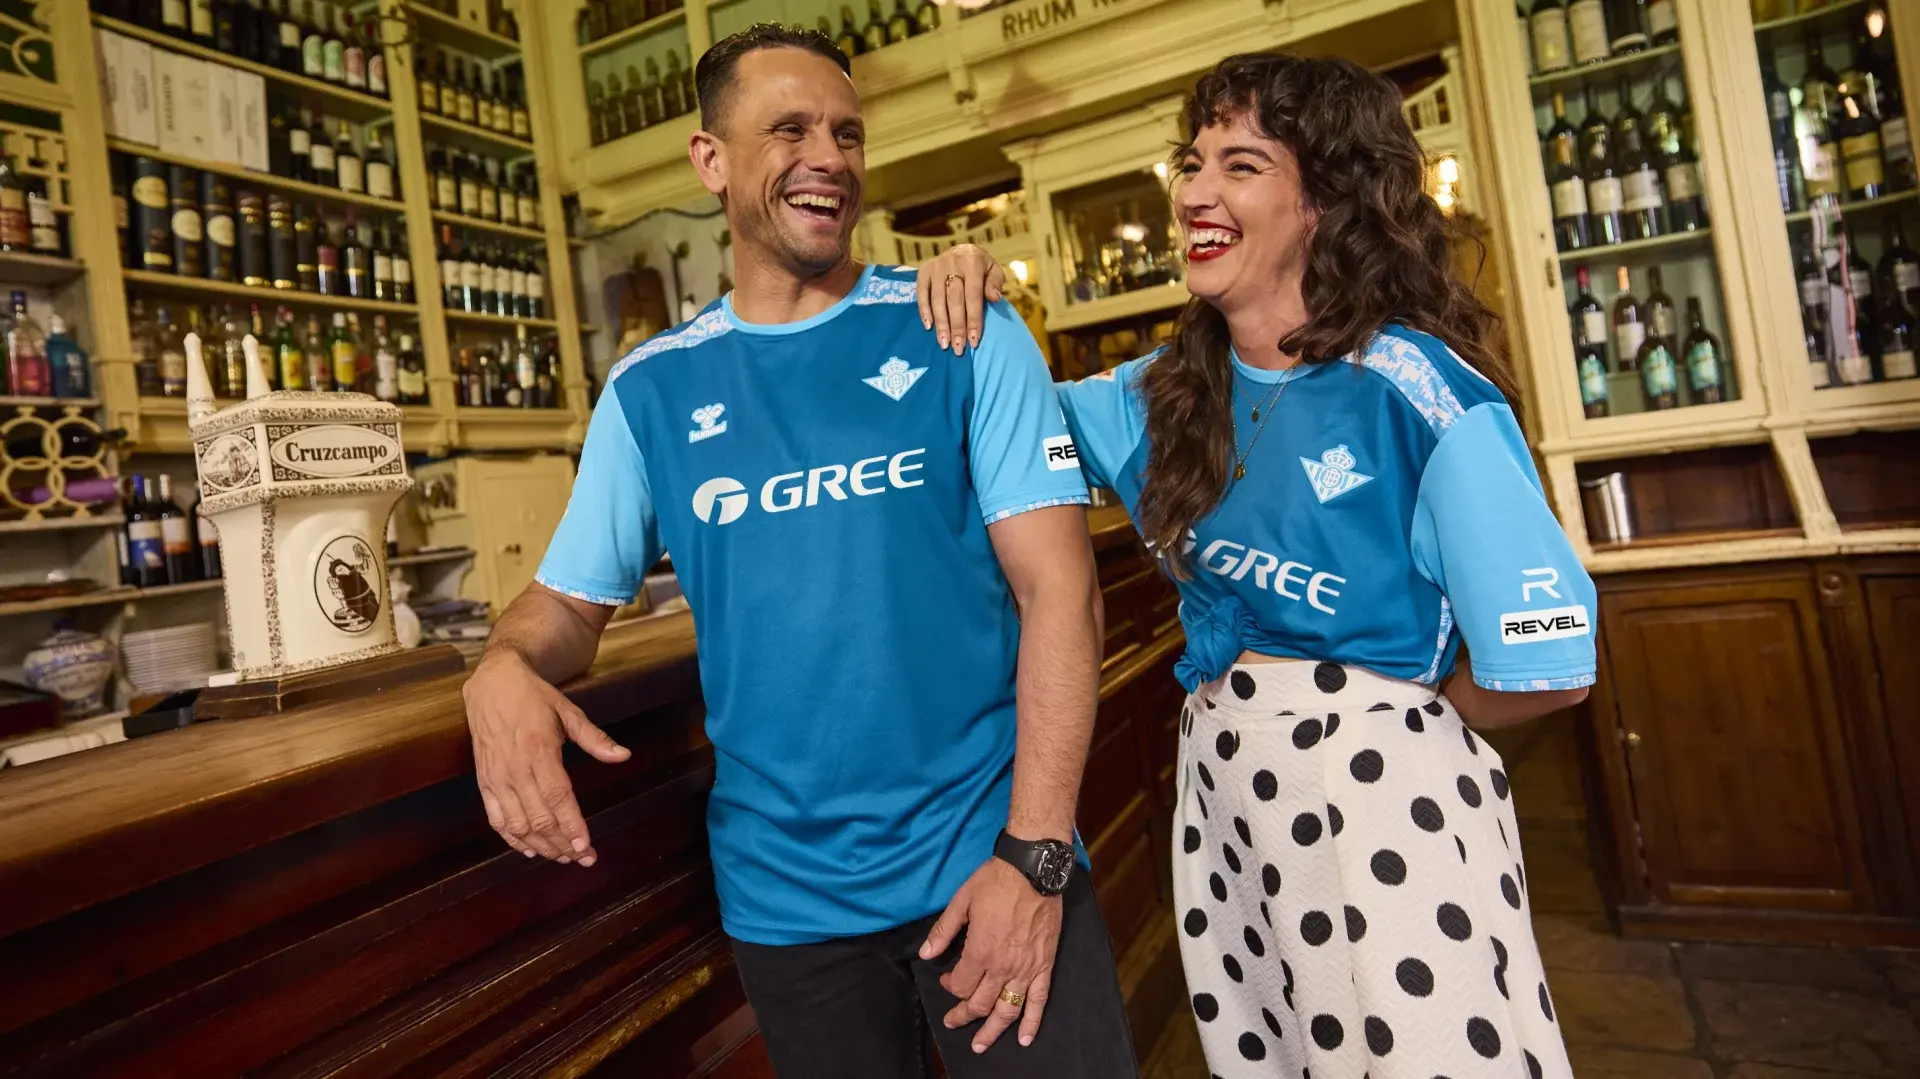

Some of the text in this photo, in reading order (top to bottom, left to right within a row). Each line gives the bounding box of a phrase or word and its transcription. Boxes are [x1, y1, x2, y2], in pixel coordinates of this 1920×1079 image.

[1001, 0, 1076, 41] RHUM
[285, 441, 388, 464] Cruzcampo
[760, 448, 926, 513] GREE
[1198, 538, 1348, 616] GREE
[1504, 615, 1586, 637] REVEL
